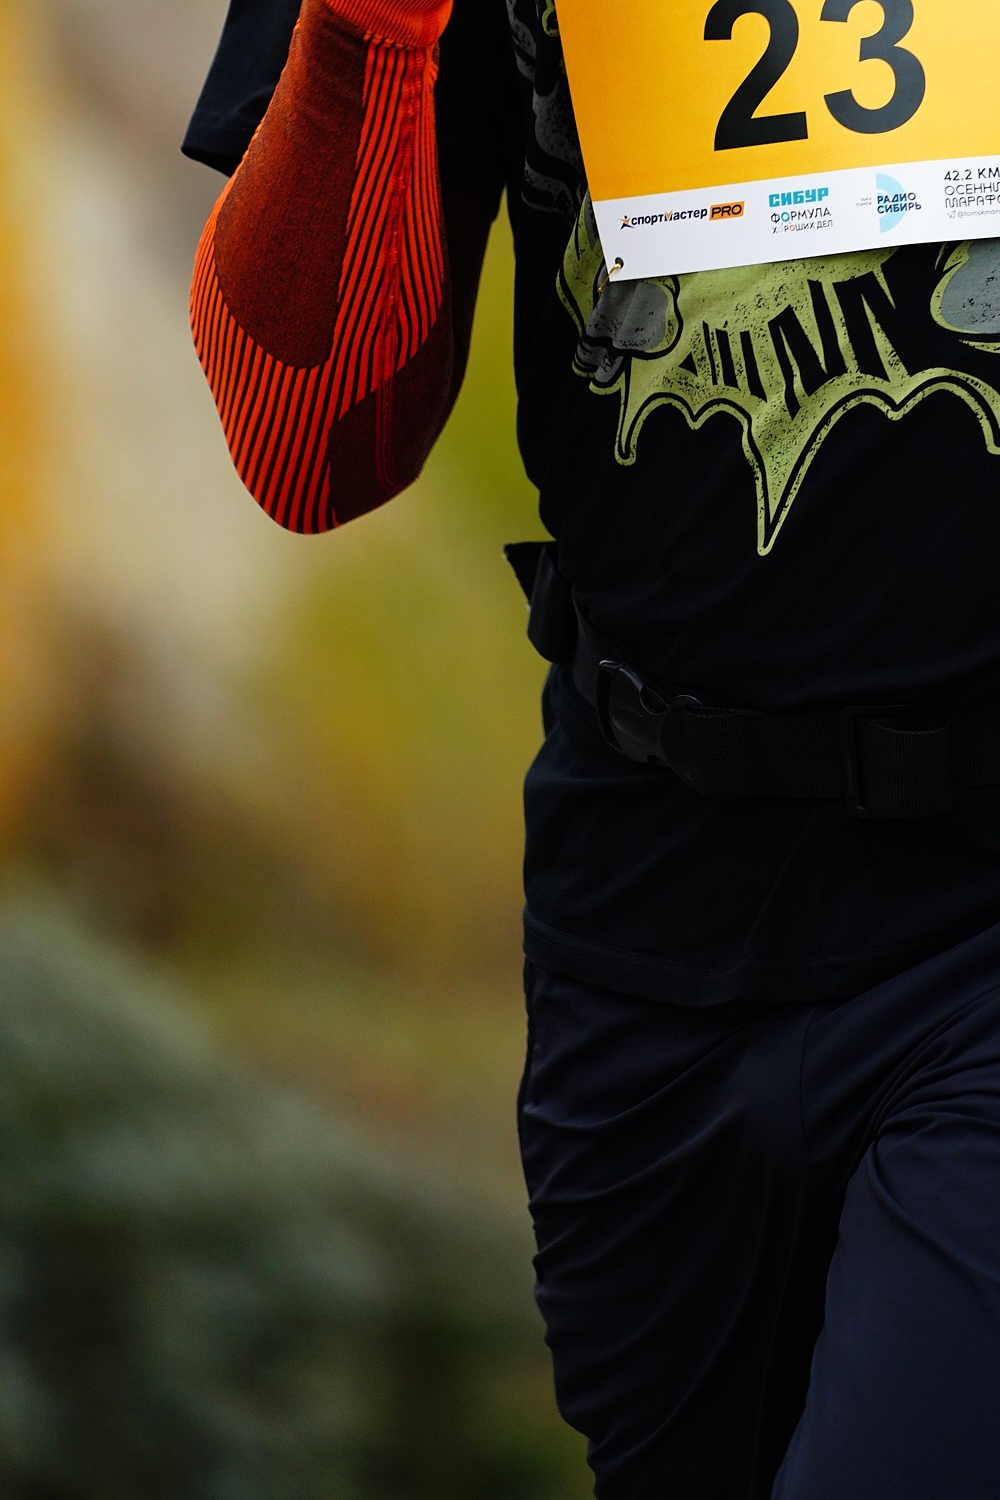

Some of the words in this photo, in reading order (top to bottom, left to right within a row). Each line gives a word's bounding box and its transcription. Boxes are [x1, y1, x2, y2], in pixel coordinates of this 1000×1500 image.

[943, 169, 973, 181] 42.2
[768, 187, 829, 208] СИБУР
[876, 192, 917, 205] РАДИО
[711, 204, 743, 219] PRO
[876, 202, 922, 214] СИБИРЬ
[770, 207, 831, 224] ФОРМУЛА
[816, 219, 833, 230] ДЕЛ
